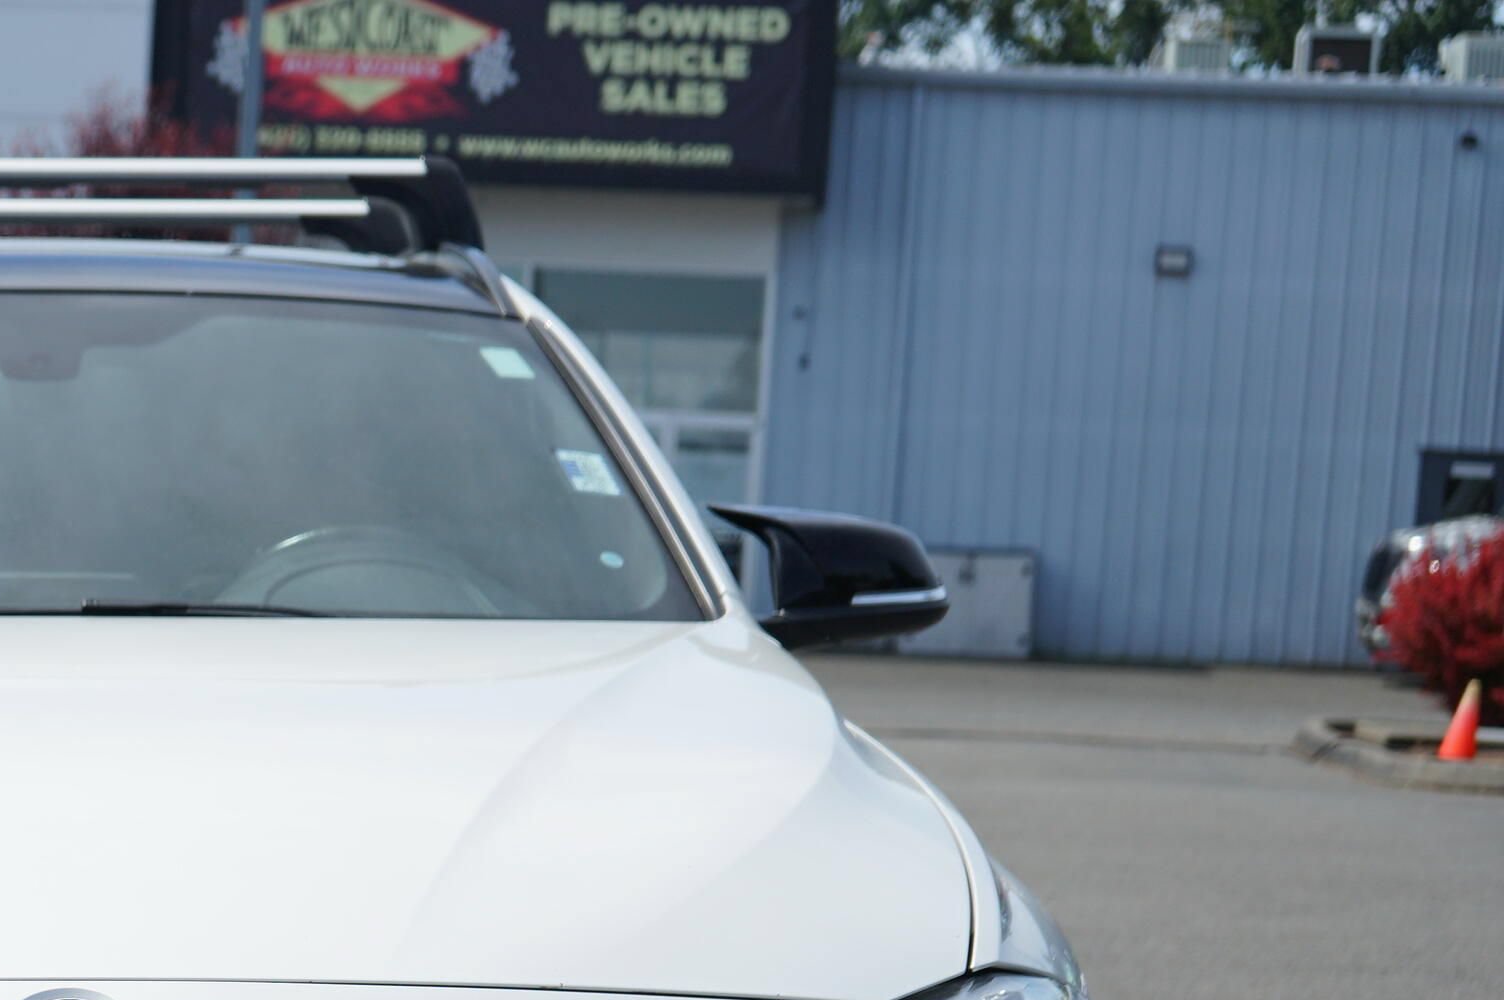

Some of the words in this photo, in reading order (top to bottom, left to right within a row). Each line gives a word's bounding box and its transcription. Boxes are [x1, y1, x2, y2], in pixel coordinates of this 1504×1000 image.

[548, 2, 790, 42] PRE-OWNED
[282, 57, 347, 74] AUTO
[583, 41, 750, 79] VEHICLE
[601, 79, 727, 117] SALES
